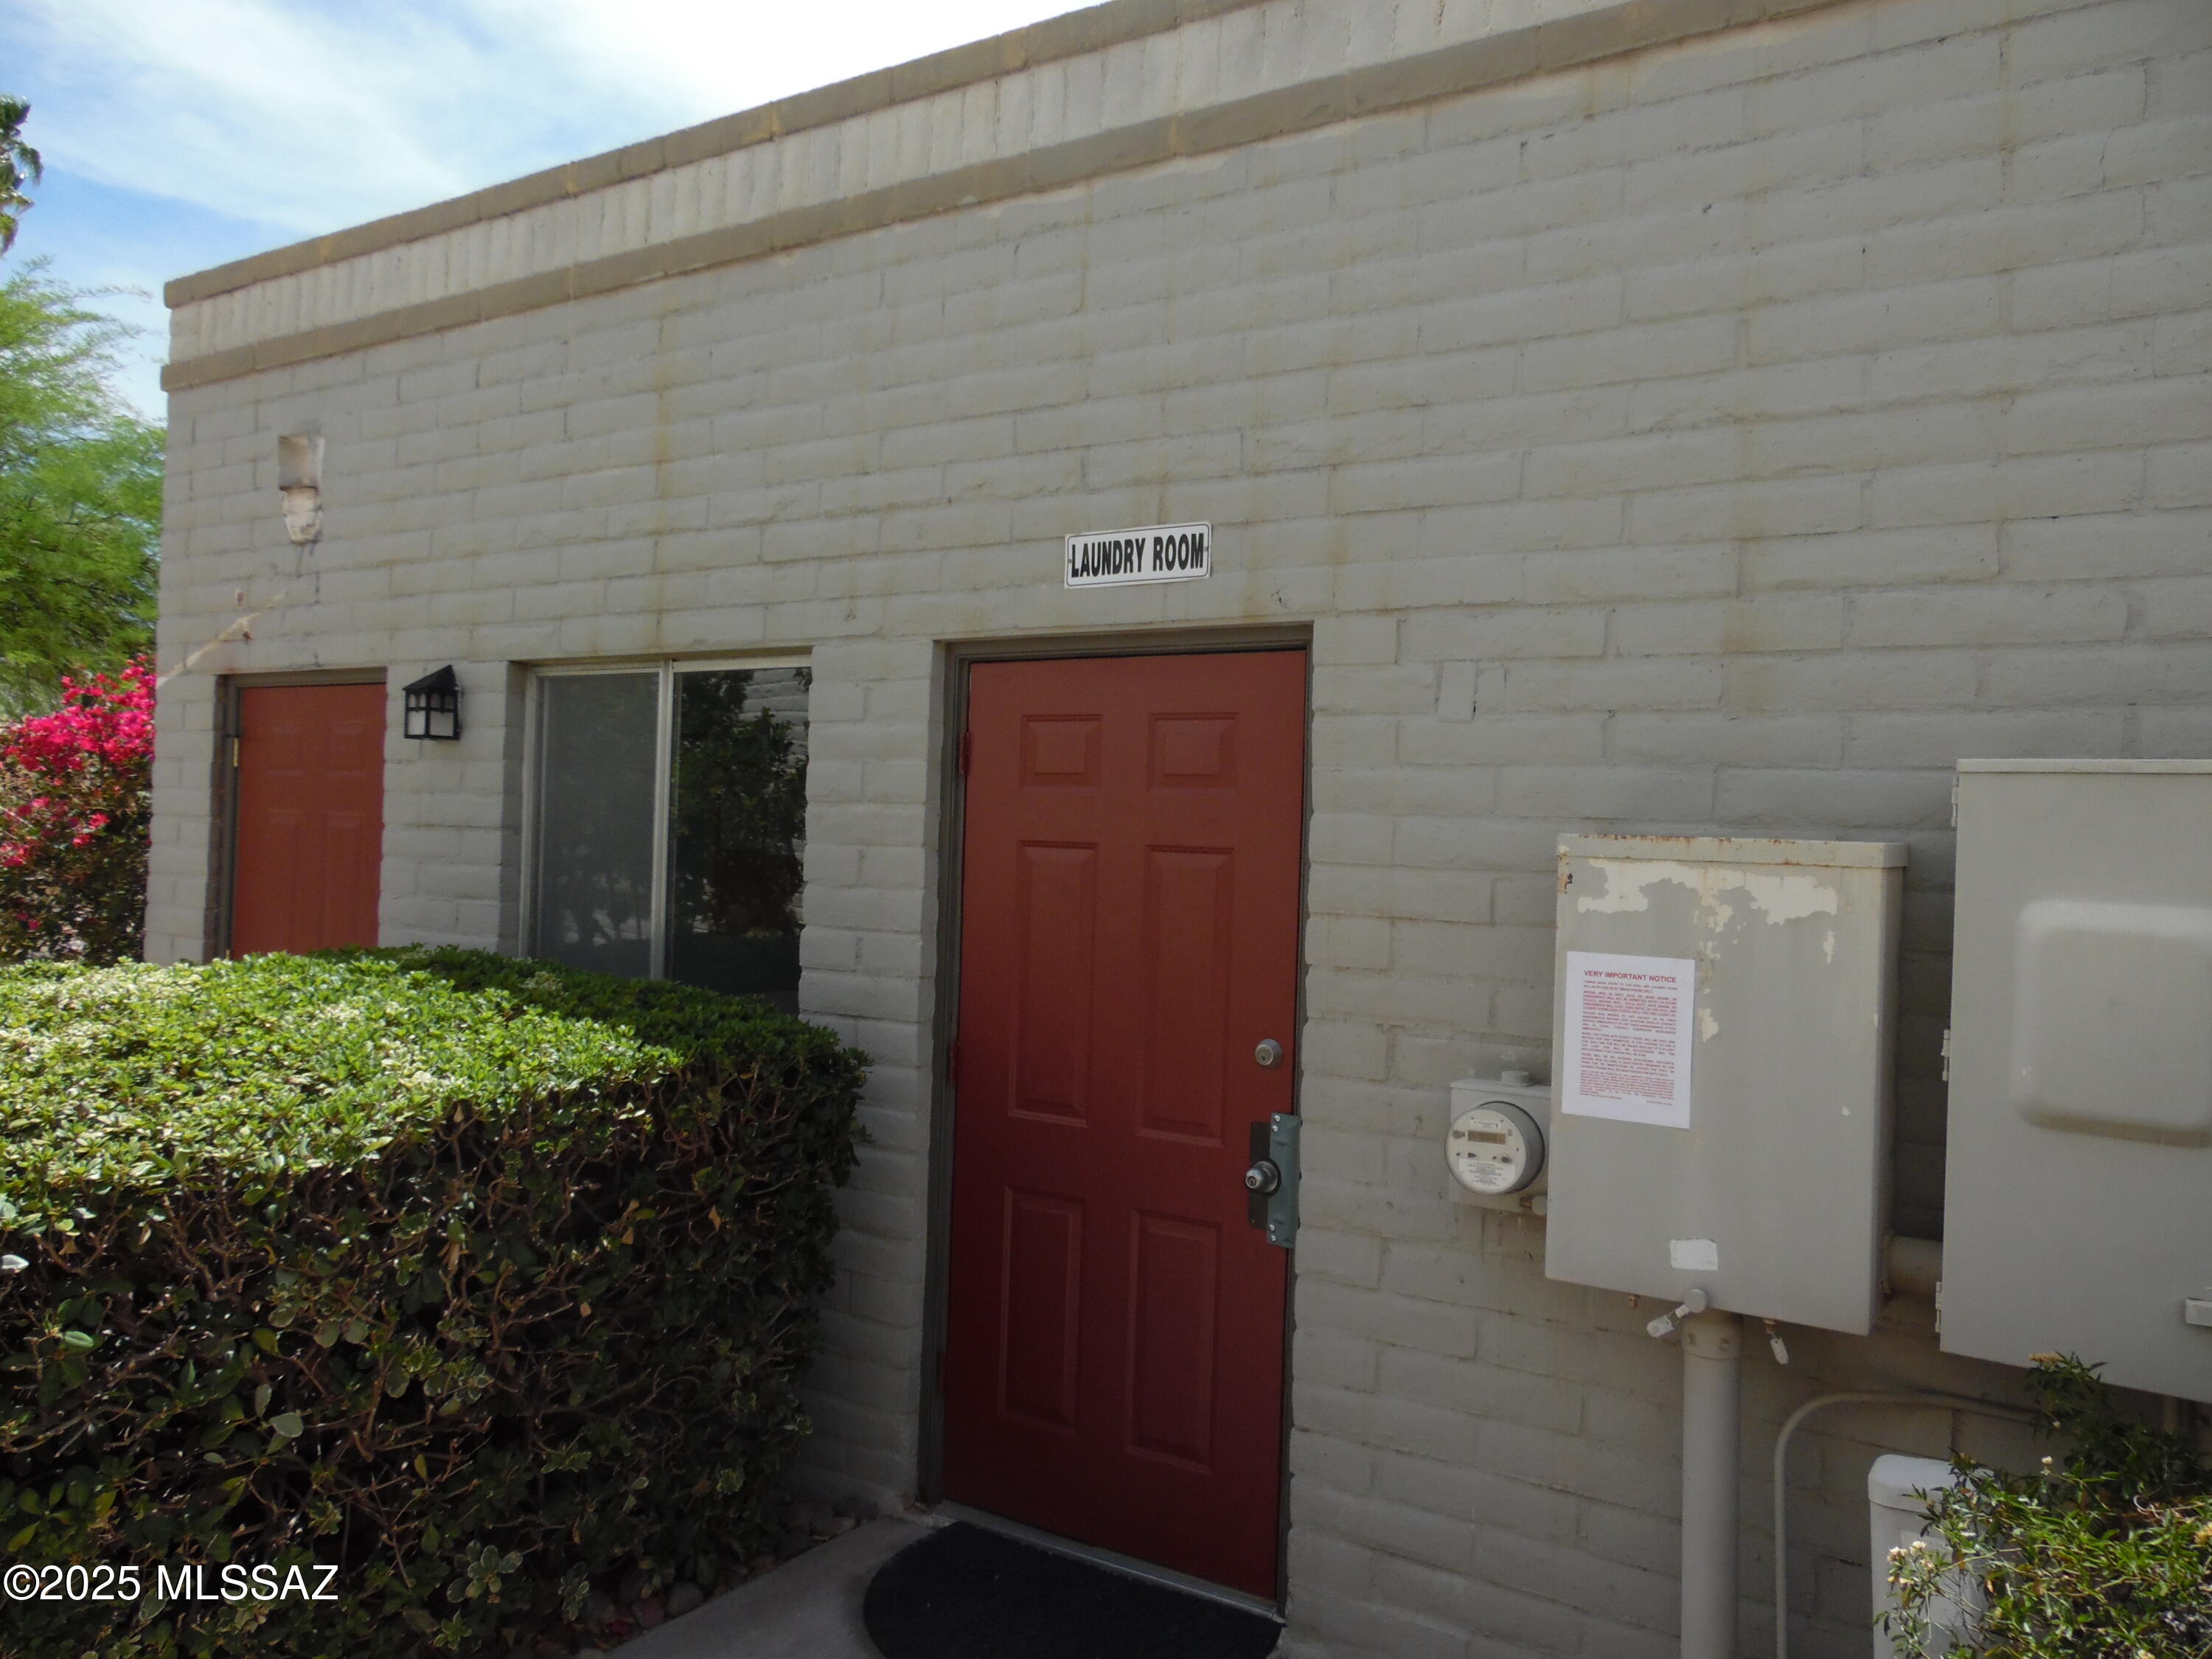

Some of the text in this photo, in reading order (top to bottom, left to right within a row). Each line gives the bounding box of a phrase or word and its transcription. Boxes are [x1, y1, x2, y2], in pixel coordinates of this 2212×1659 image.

[1071, 532, 1204, 578] LAUNDRY ROOM
[1584, 970, 1677, 984] VERY IMPORTANT NOTICE
